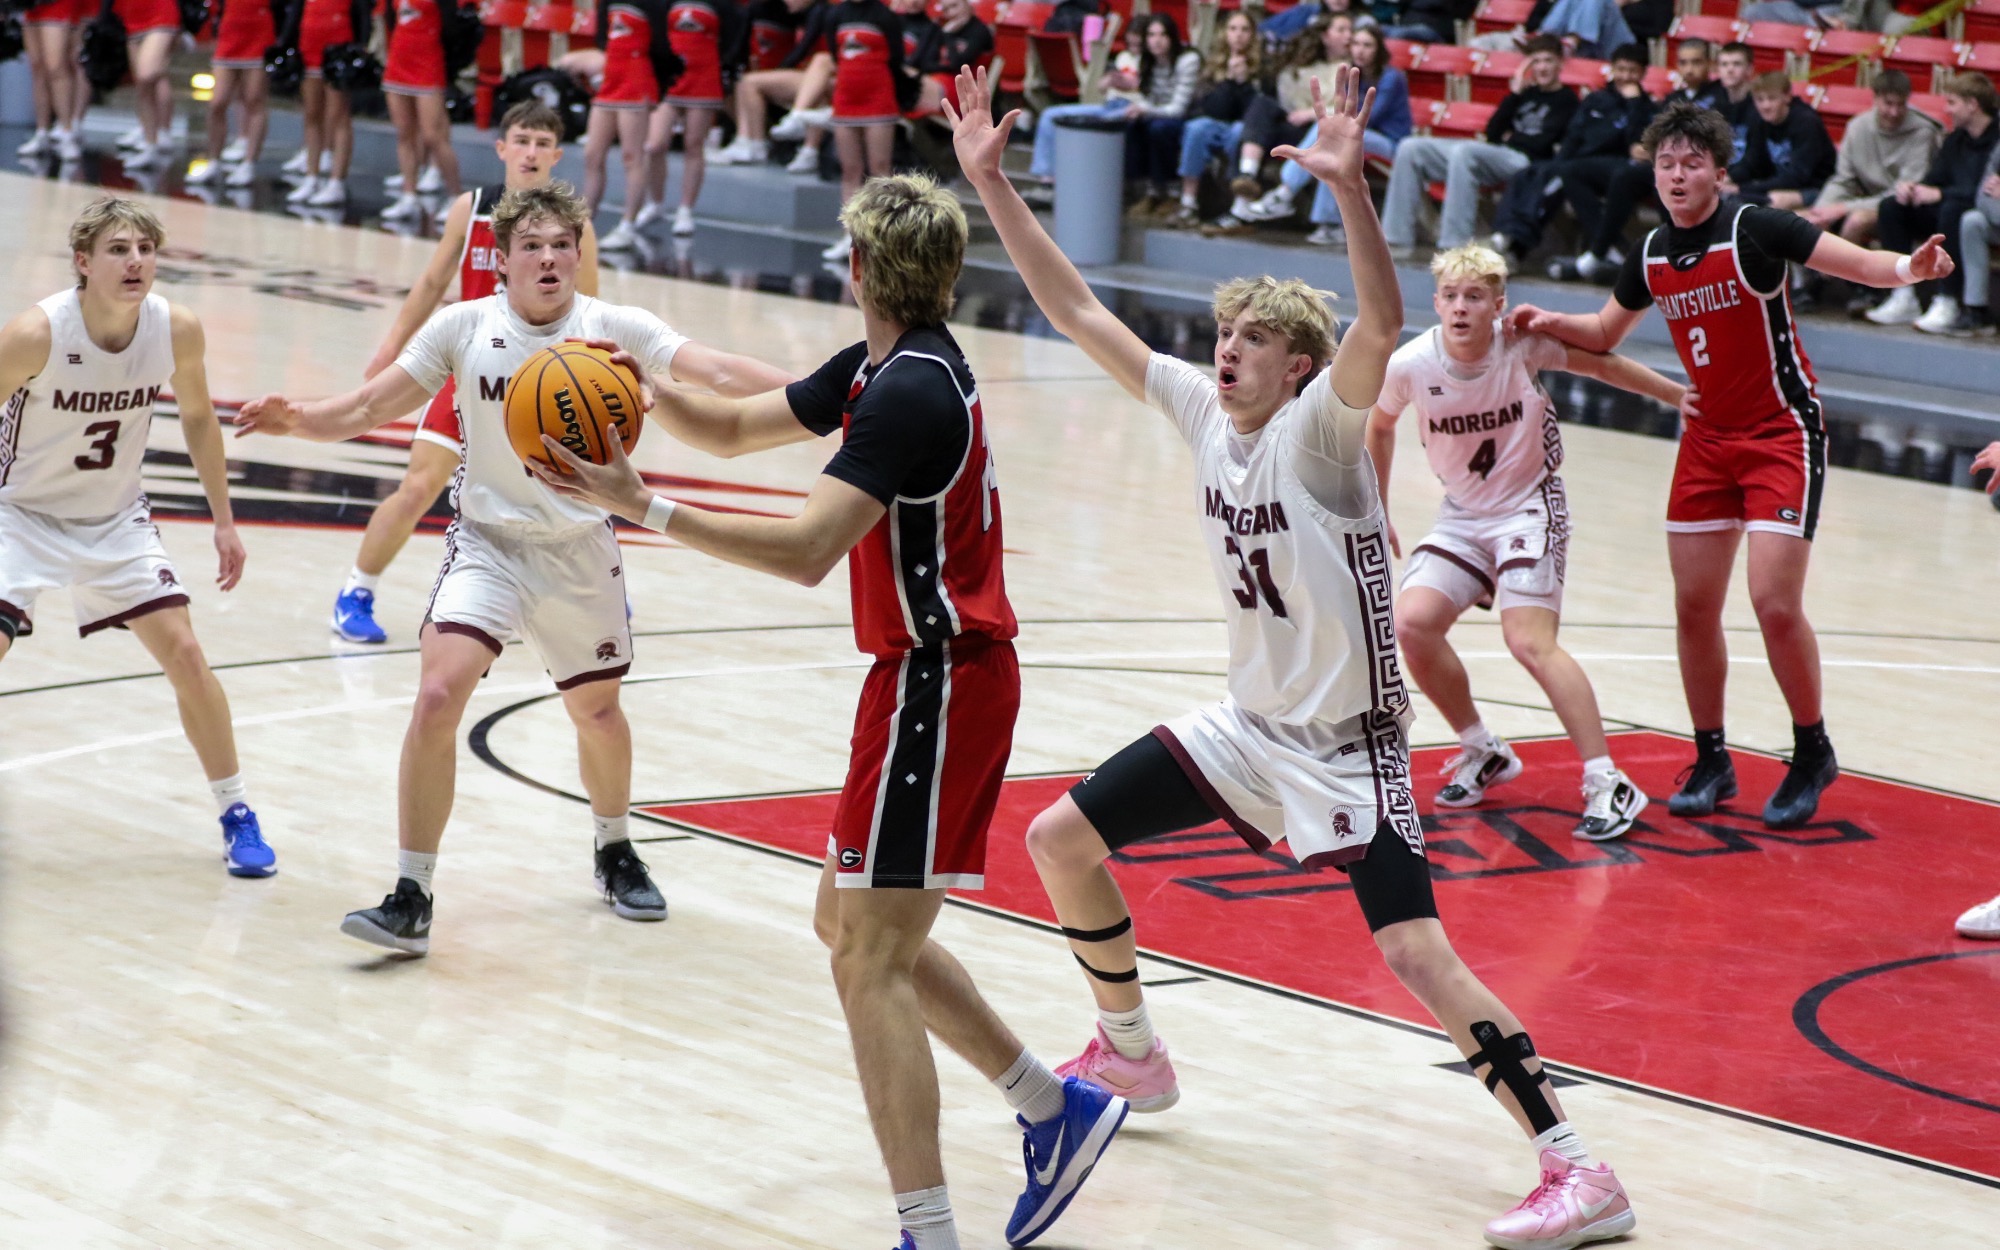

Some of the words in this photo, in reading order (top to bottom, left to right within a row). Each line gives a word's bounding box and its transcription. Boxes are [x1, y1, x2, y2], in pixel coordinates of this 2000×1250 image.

[1654, 279, 1741, 321] RANTSVILLE
[1688, 326, 1711, 368] 2
[52, 384, 161, 413] MORGAN
[1429, 400, 1524, 435] MORGAN
[74, 420, 121, 471] 3
[1468, 438, 1497, 481] 4
[1224, 535, 1288, 618] 31
[841, 849, 862, 865] G
